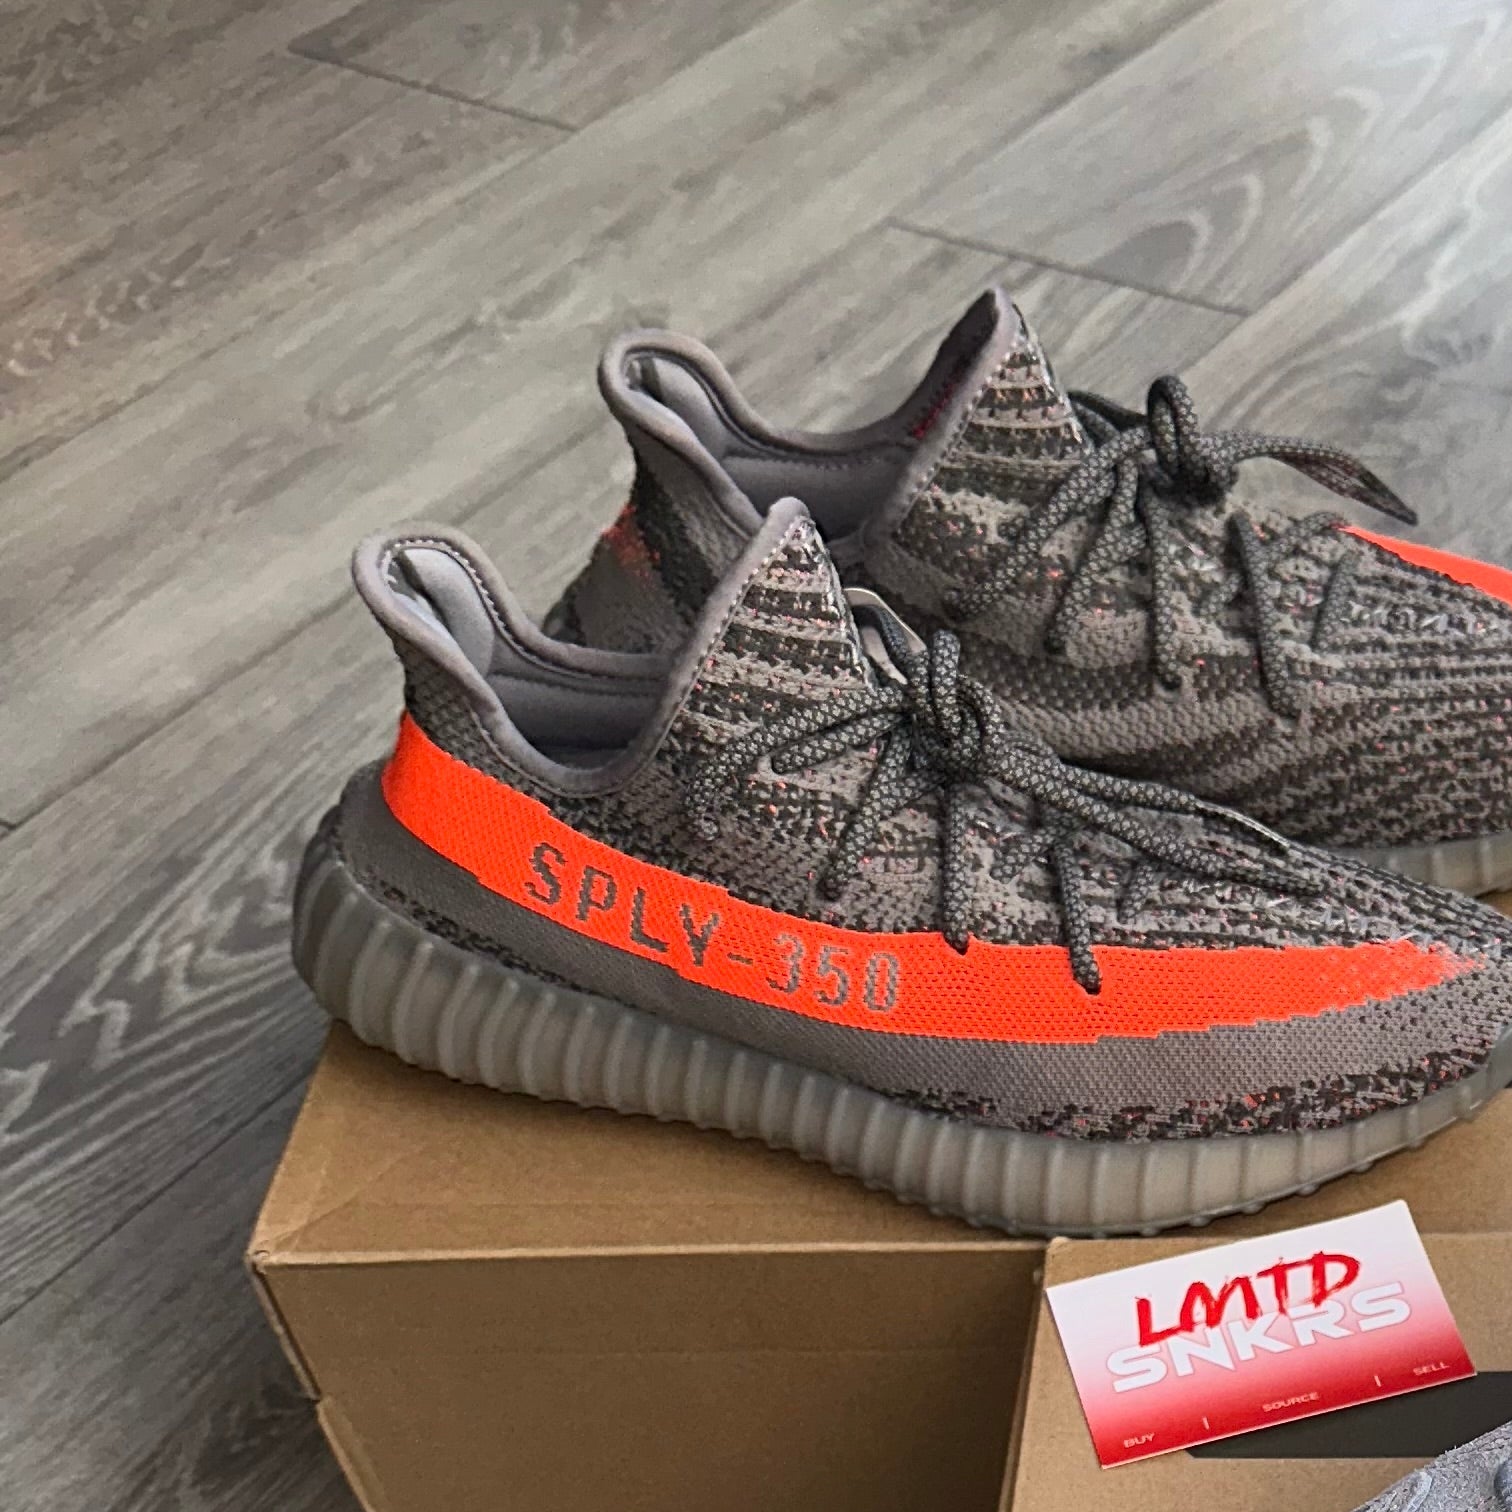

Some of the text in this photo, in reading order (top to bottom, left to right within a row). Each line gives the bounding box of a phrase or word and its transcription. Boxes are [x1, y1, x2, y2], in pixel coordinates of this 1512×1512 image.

[524, 841, 899, 1012] SPLY-350
[1106, 1282, 1412, 1394] SNKRS
[1134, 1250, 1361, 1347] LMTD
[1123, 1361, 1451, 1448] BUY SOURCE SELL
